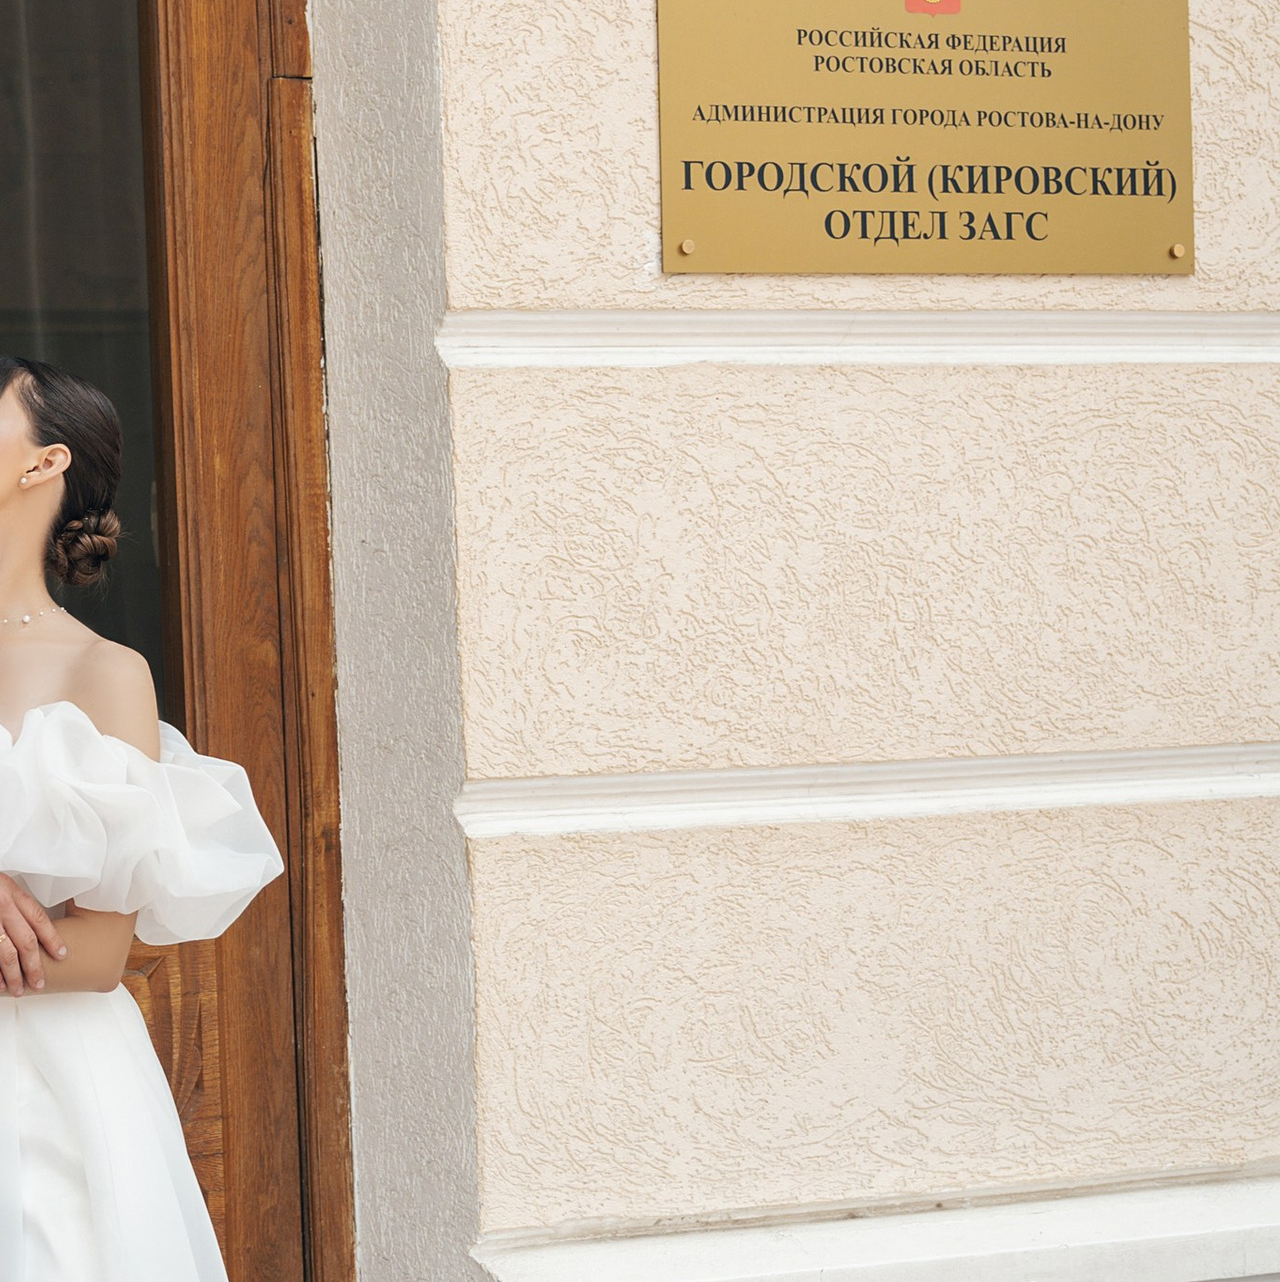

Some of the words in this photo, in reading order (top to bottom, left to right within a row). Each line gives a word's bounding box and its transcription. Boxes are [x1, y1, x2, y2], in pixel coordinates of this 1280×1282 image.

[797, 26, 940, 50] РОССИЙСКАЯ
[945, 34, 1066, 55] ФЕДЕРАЦИЯ
[814, 55, 953, 76] РОСТОВСКАЯ
[958, 59, 1052, 78] ОБЛАСТЬ
[692, 104, 885, 127] АДМИНИСТРАЦИЯ
[891, 108, 971, 128] ГОРОДА
[977, 110, 1164, 133] РОСТОВА-НА-ДОНУ
[681, 155, 917, 198] ГОРОДСКОЙ
[927, 160, 1177, 204] (КИРОВСКИЙ)
[824, 209, 949, 247] ОТДЕЛ
[959, 210, 1049, 242] ЗАГС
